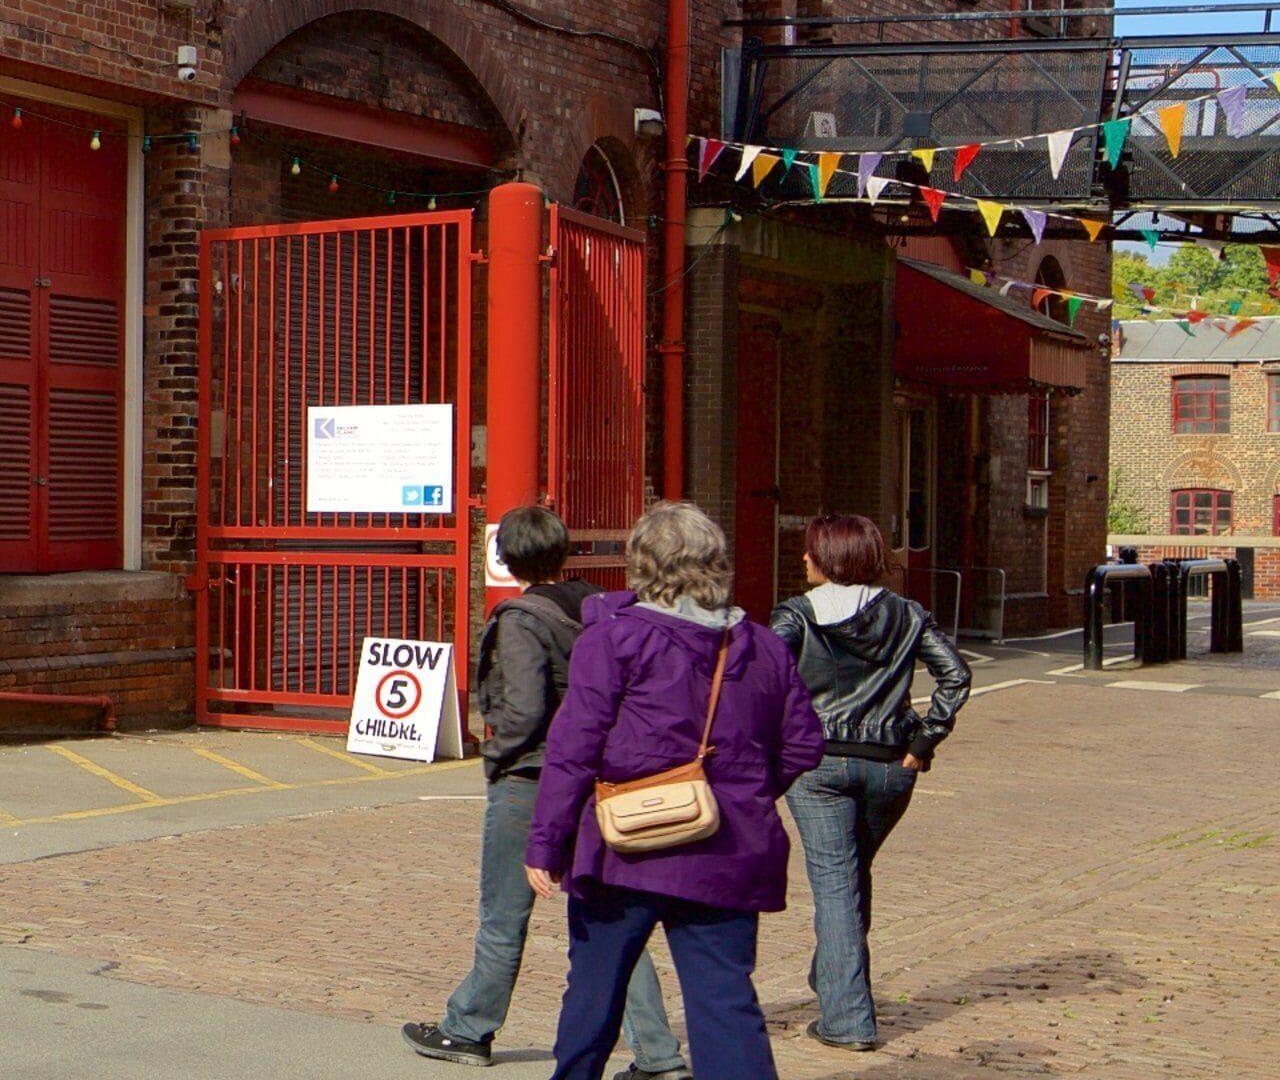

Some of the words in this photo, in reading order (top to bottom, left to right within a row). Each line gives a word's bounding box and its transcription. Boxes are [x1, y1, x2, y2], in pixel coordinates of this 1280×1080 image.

[367, 641, 444, 671] SLOW
[386, 679, 408, 709] 5
[355, 717, 422, 742] CHILDRE
